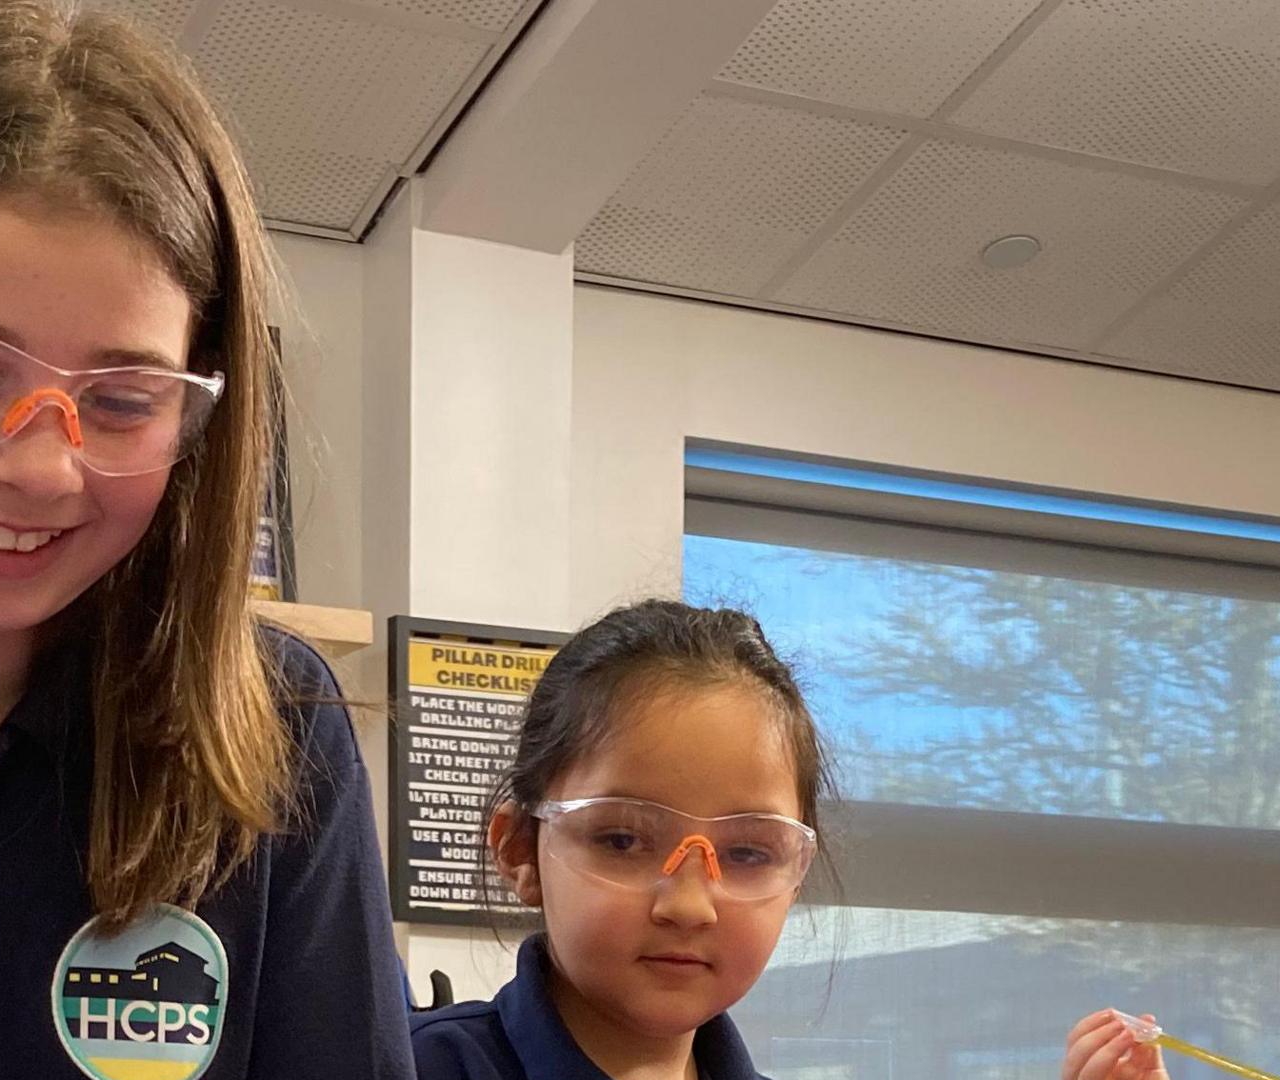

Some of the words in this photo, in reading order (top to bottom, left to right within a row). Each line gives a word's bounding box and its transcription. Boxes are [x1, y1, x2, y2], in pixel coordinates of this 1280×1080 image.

[431, 647, 497, 668] PILLAR
[500, 653, 549, 672] DRIL
[411, 695, 456, 712] PLACE
[457, 699, 485, 714] THE
[420, 711, 493, 729] DRILLING
[411, 736, 458, 752] BRING
[459, 740, 500, 754] DOWN
[502, 744, 519, 756] TH
[433, 753, 453, 767] TO
[454, 756, 492, 770] MEET
[424, 768, 469, 783] CHECK
[451, 794, 480, 808] THE
[412, 829, 440, 843] USE
[441, 831, 452, 844] A
[418, 870, 473, 885] ENSURE
[409, 885, 450, 899] DOWN
[79, 996, 211, 1046] HCPS
